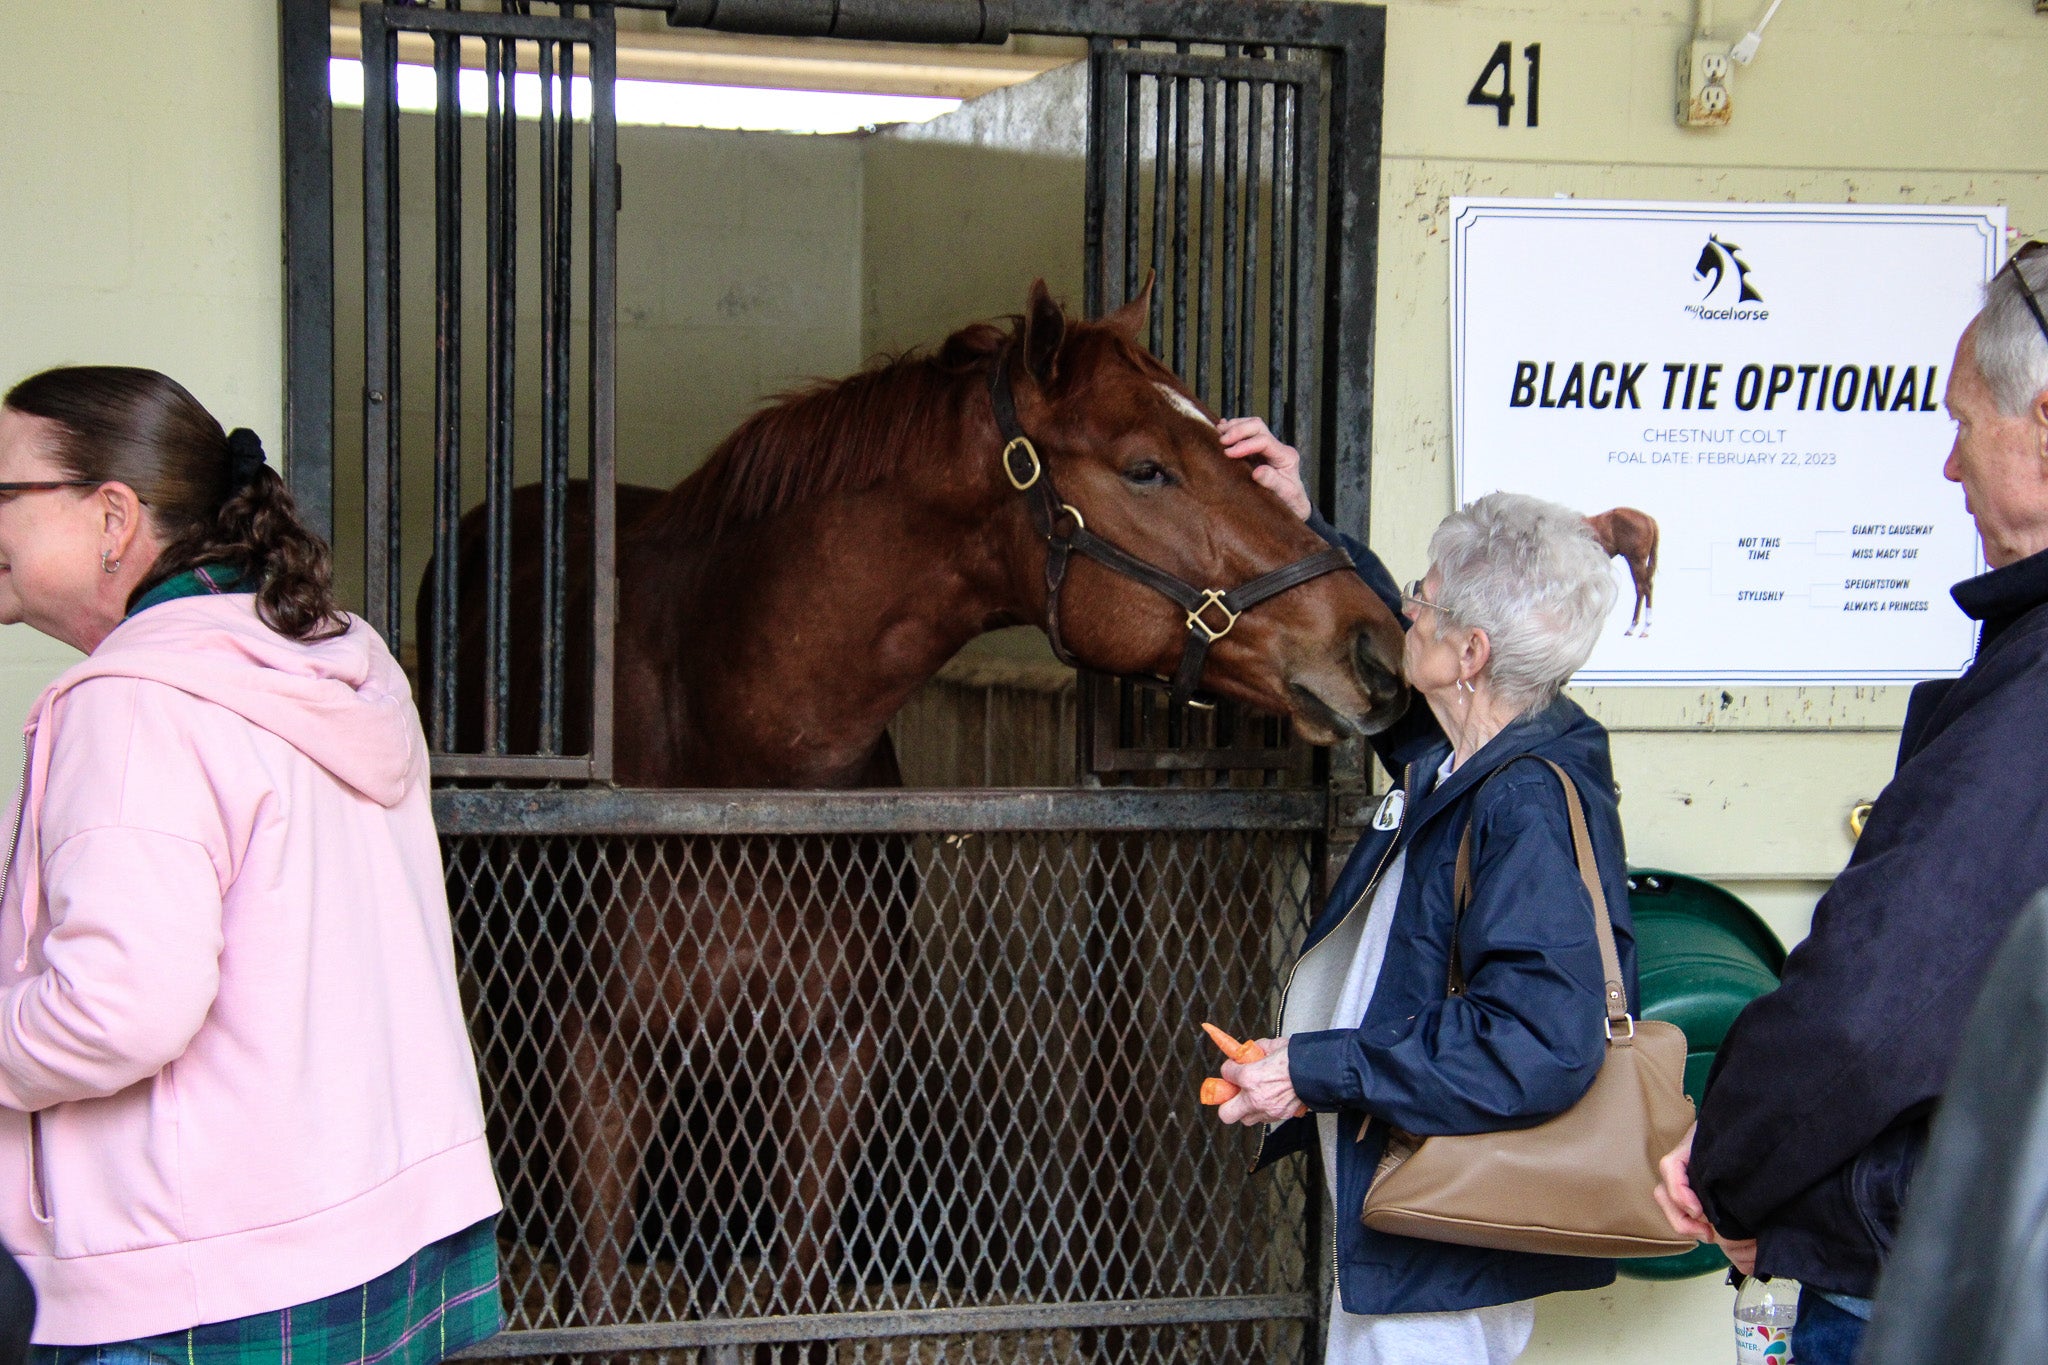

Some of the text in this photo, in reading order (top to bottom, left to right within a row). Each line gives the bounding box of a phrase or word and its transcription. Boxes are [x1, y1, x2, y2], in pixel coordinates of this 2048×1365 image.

[1467, 41, 1540, 127] 41
[1510, 361, 1937, 412] BLACK TIE OPTIONAL
[1643, 428, 1787, 444] CHESTNUT COLT
[1608, 451, 1837, 466] FOAL DATE: FEBRUARY 22, 2023
[1851, 524, 1934, 536] GIANT'S CAUSEWAY
[1738, 536, 1781, 548] NOT THIS
[1748, 549, 1771, 560] TIME
[1851, 548, 1919, 560] MISS MACY SUE
[1844, 578, 1910, 590] SPEIGHTSTOWN
[1737, 590, 1785, 602] STYLISHLY
[1843, 600, 1929, 612] ALWAYS A PRINCESS
